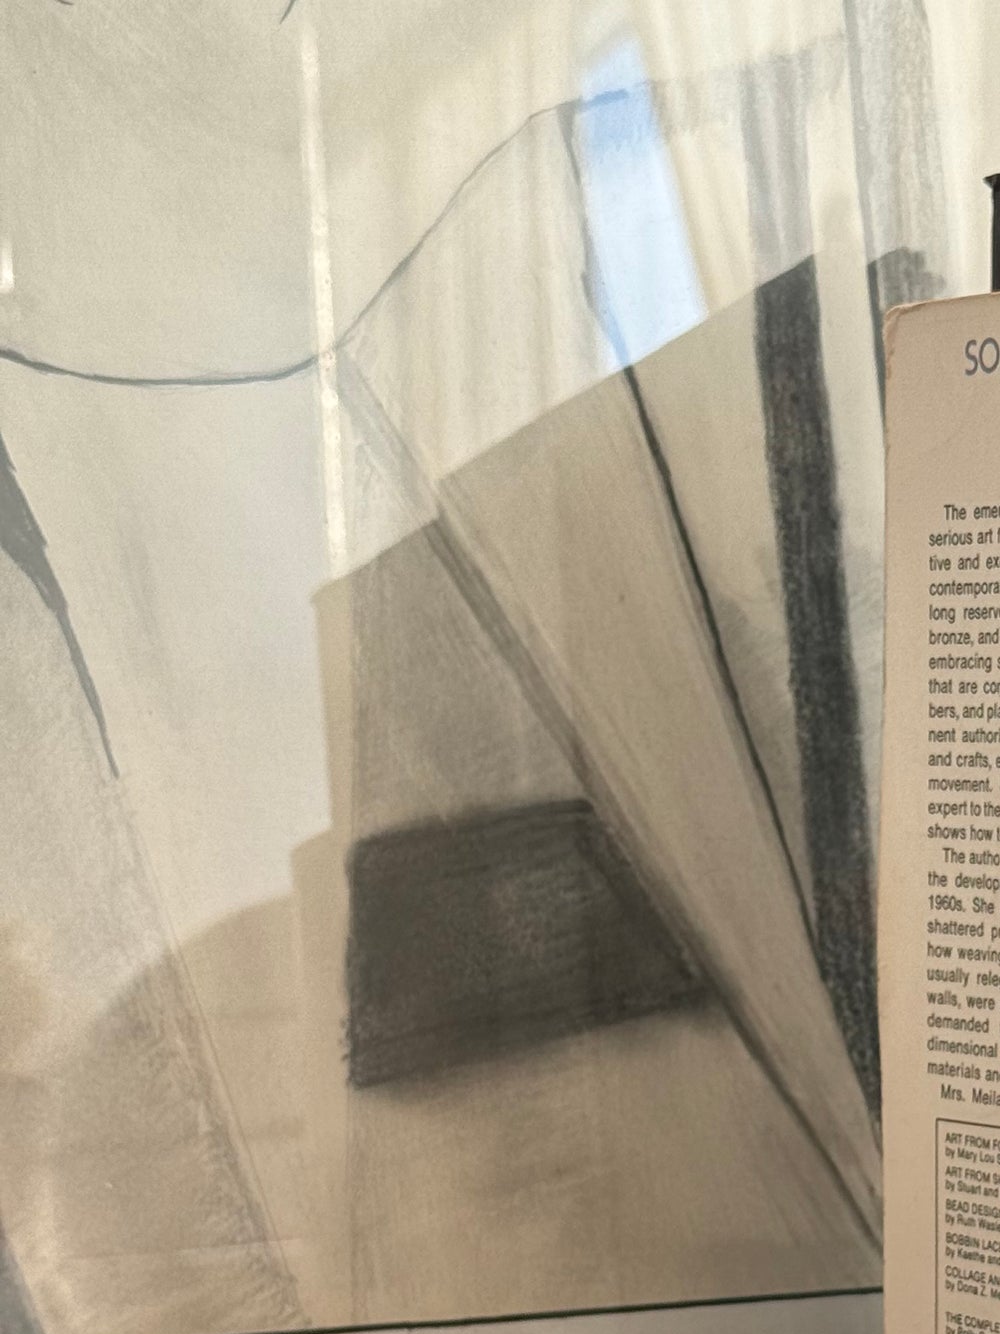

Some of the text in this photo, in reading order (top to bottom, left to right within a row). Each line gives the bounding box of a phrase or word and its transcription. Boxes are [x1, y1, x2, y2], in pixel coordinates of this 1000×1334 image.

[944, 504, 966, 521] The
[929, 529, 973, 547] serious
[977, 528, 993, 544] art
[929, 556, 951, 572] tive
[957, 554, 980, 570] and
[928, 728, 956, 742] nent
[928, 801, 968, 819] expert
[970, 803, 981, 816] to
[984, 803, 1000, 818] the
[928, 824, 966, 839] shows
[970, 825, 993, 841] how
[943, 847, 965, 864] The
[928, 872, 947, 887] the
[945, 1166, 962, 1178] ART
[965, 1170, 990, 1182] FROM
[946, 1199, 969, 1212] BEAD
[946, 1232, 980, 1248] BOBBIN
